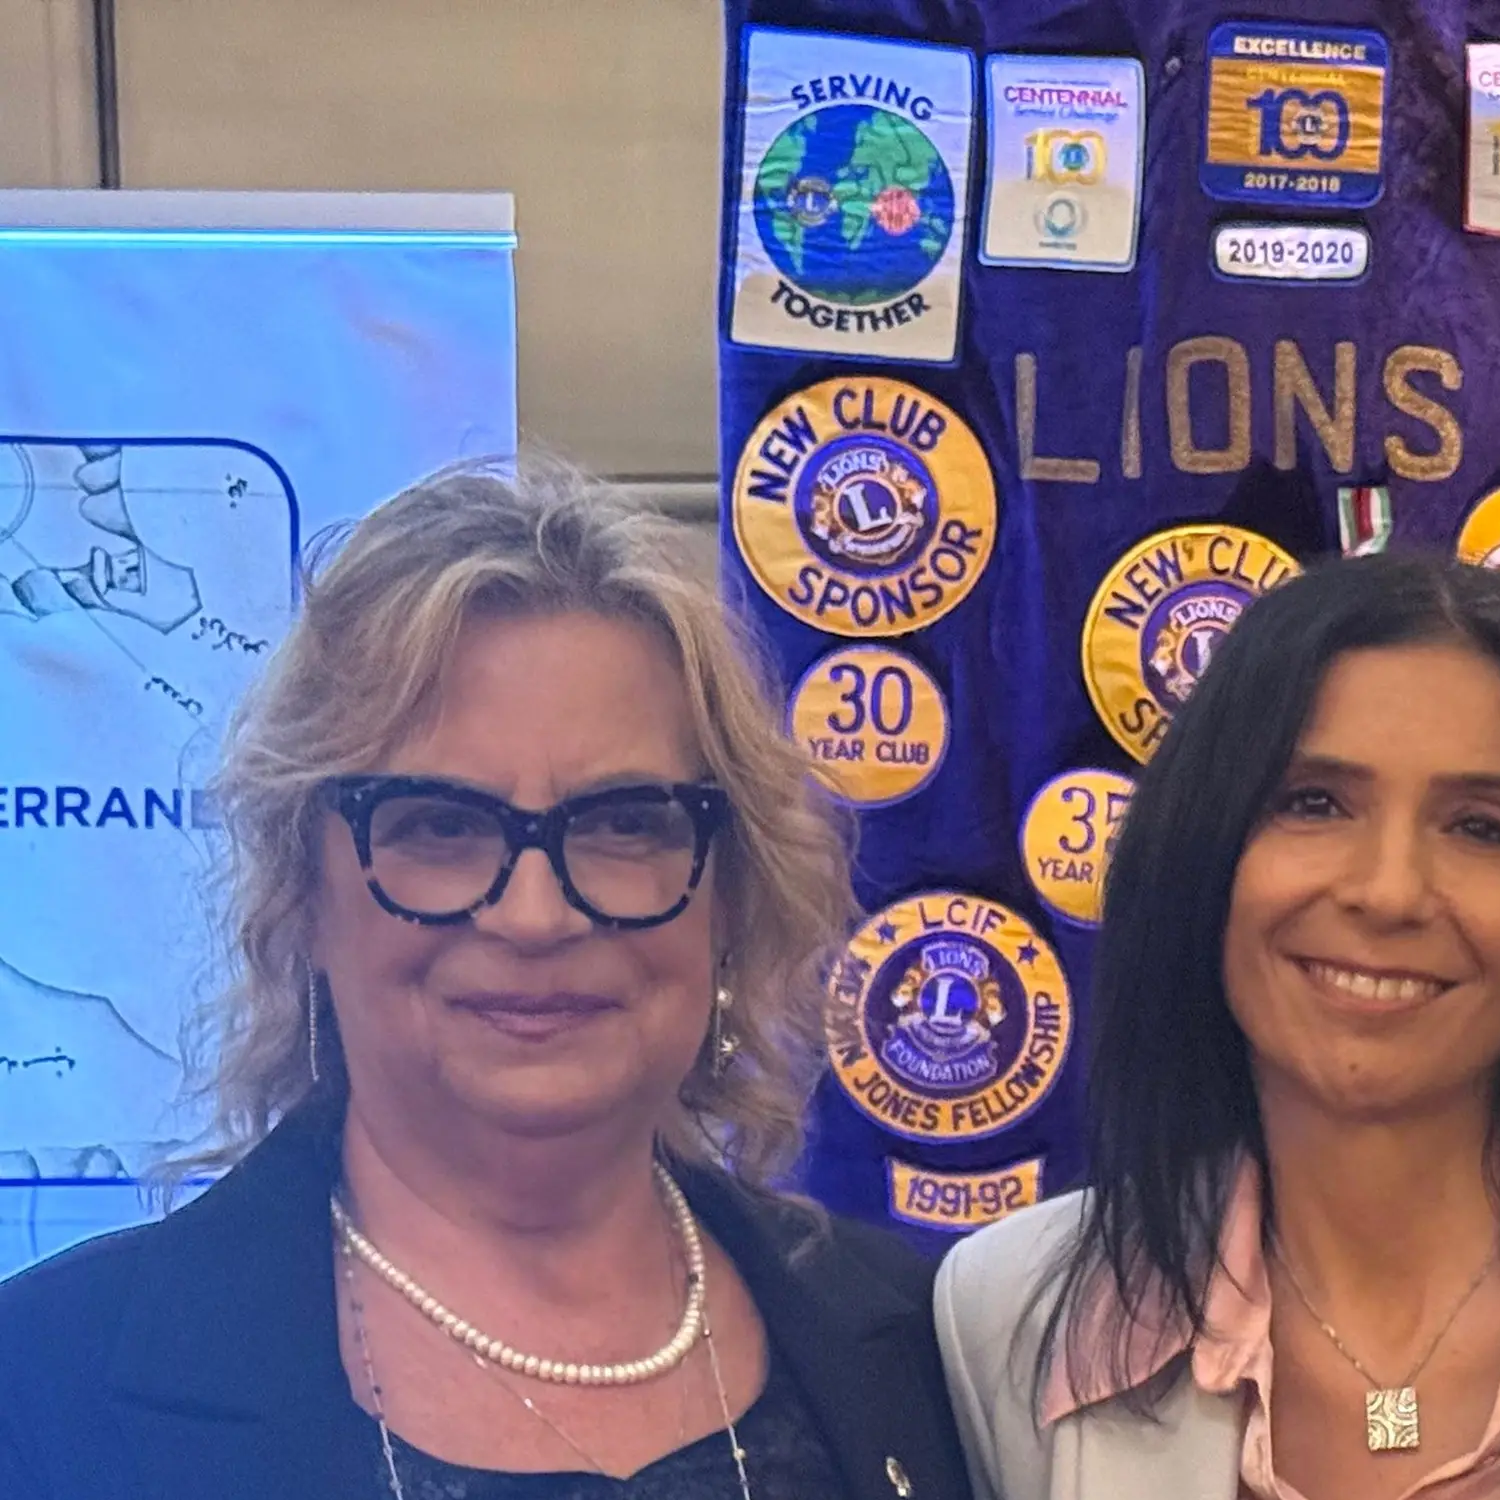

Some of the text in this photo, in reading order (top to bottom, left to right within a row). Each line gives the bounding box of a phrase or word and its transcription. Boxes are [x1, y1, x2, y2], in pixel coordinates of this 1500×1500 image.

[1234, 36, 1366, 59] EXCELLENCE
[791, 74, 933, 121] SERVING
[1004, 86, 1128, 108] CENTENNIAL
[1244, 171, 1341, 193] 2017-2018
[1228, 239, 1354, 265] 2019-2020
[771, 281, 931, 333] TOGETHER
[1015, 336, 1463, 481] LIONS
[748, 387, 947, 504] NEW CLUB
[824, 452, 888, 485] LIONS
[843, 483, 892, 532] L
[788, 519, 982, 628] SPONSOR
[1104, 536, 1290, 630] NEW CLU
[1177, 601, 1241, 624] LIONS
[827, 664, 913, 736] 30
[808, 739, 930, 764] YEAR CLUB
[1038, 858, 1093, 882] YEAR
[918, 899, 1007, 935] LCIF
[927, 950, 982, 974] LIONS
[930, 979, 962, 1024] L
[853, 1072, 941, 1130] JONES
[951, 991, 1061, 1131] FELLOWSHIP
[890, 1041, 989, 1081] FOUNDATION
[906, 1176, 1025, 1218] 1991-92
